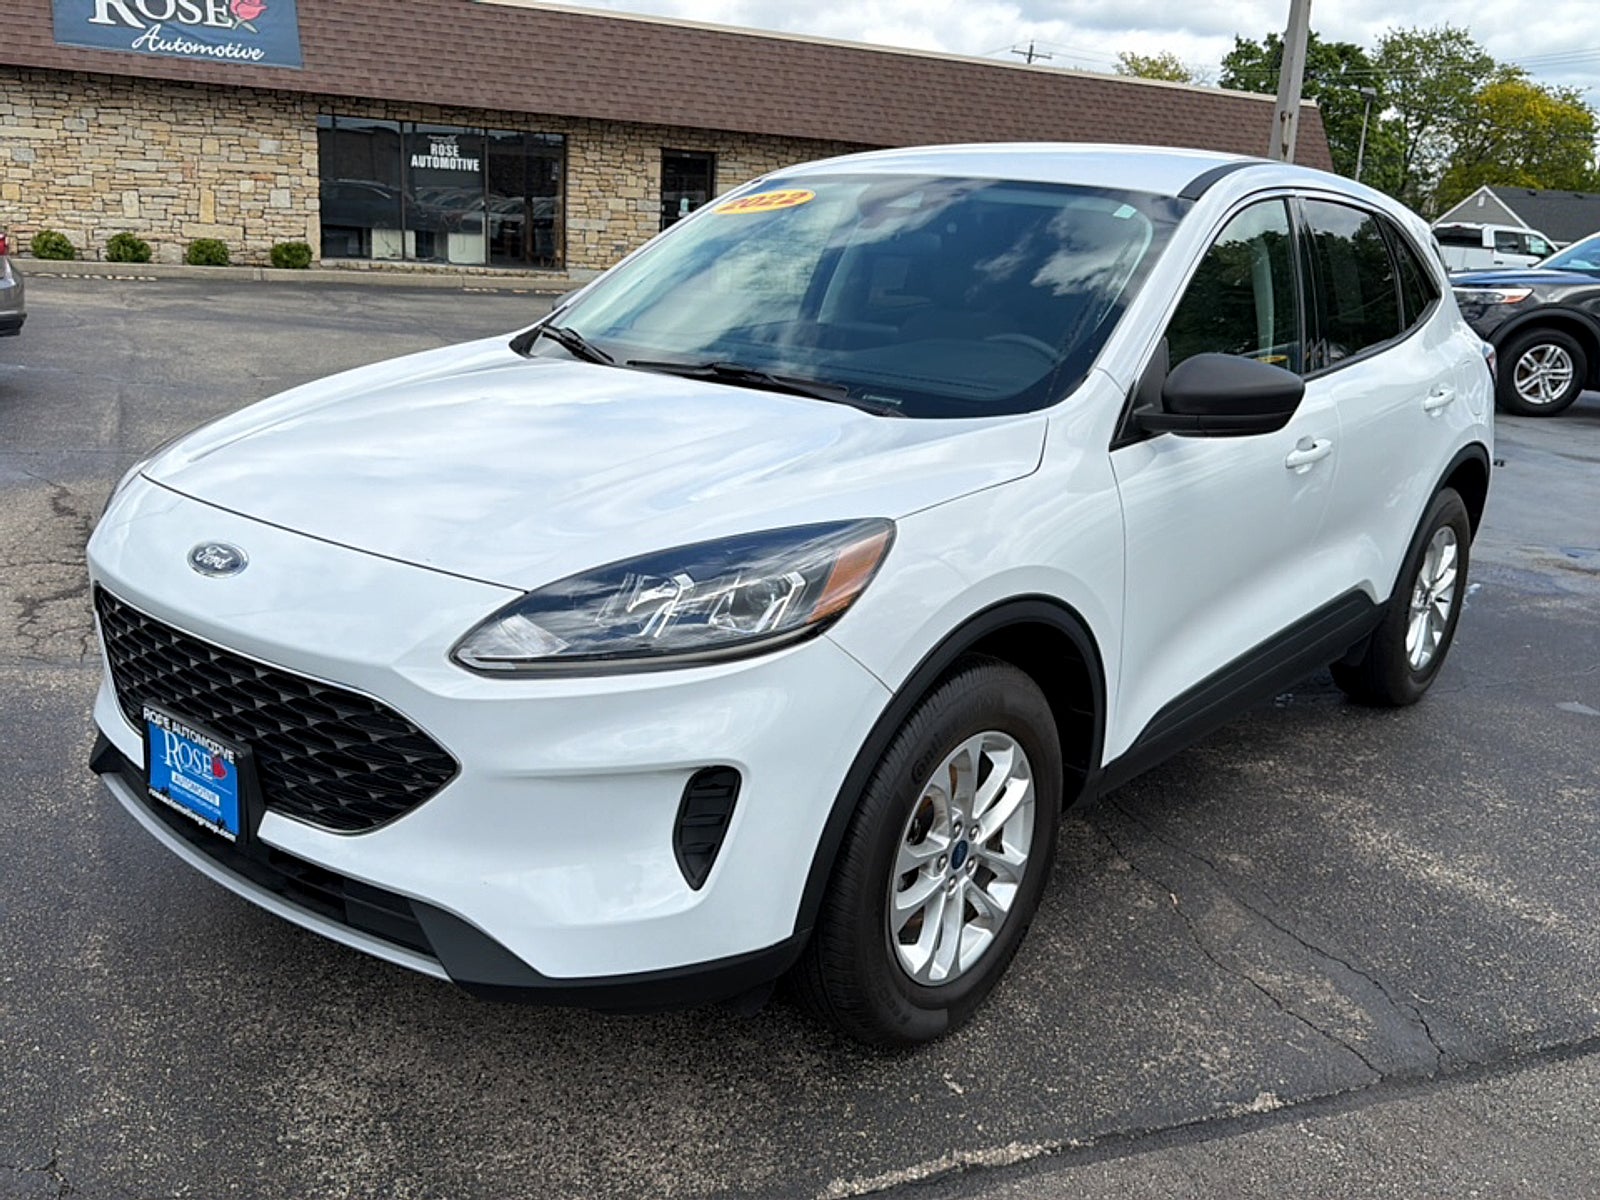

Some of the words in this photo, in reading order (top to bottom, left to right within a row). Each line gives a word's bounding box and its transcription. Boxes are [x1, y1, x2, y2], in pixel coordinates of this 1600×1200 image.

[131, 23, 265, 61] Automotive
[430, 143, 460, 157] ROSE
[411, 154, 480, 172] AUTOMOTIVE
[195, 545, 233, 570] Ford
[162, 729, 214, 780] ROSE
